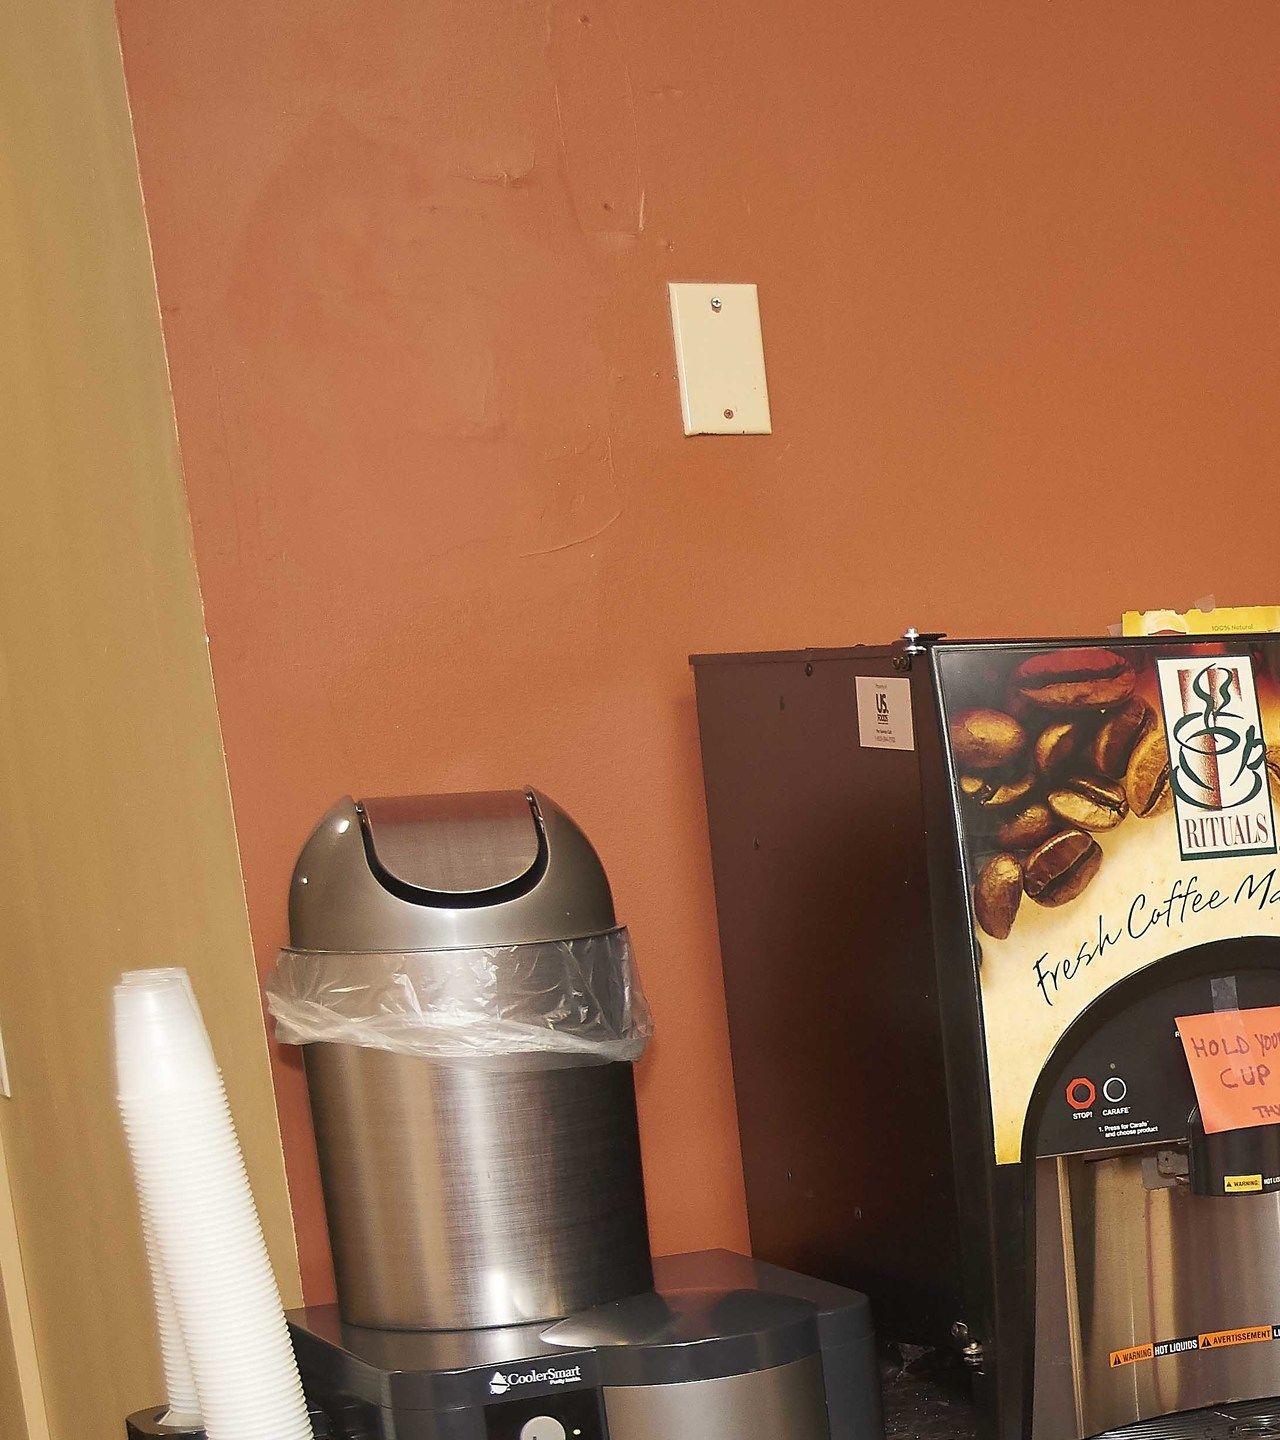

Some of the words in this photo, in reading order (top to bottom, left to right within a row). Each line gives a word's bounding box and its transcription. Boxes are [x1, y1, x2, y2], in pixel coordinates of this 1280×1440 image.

[1184, 812, 1269, 849] RITUALS
[1032, 915, 1122, 1006] Fresh
[1127, 876, 1229, 939] Coffee
[1190, 1035, 1250, 1058] HOLD
[1220, 1064, 1271, 1089] CUP
[1072, 1111, 1093, 1120] STOP!
[1105, 1130, 1116, 1138] and
[1116, 1128, 1136, 1136] choose
[1136, 1126, 1158, 1135] product
[1122, 1347, 1152, 1363] WARNING
[1154, 1343, 1168, 1356] HOT
[1169, 1339, 1198, 1353] LIQUIDS
[1213, 1330, 1271, 1344] AVERTISSEMENT
[508, 1366, 581, 1385] CoolerSmart
